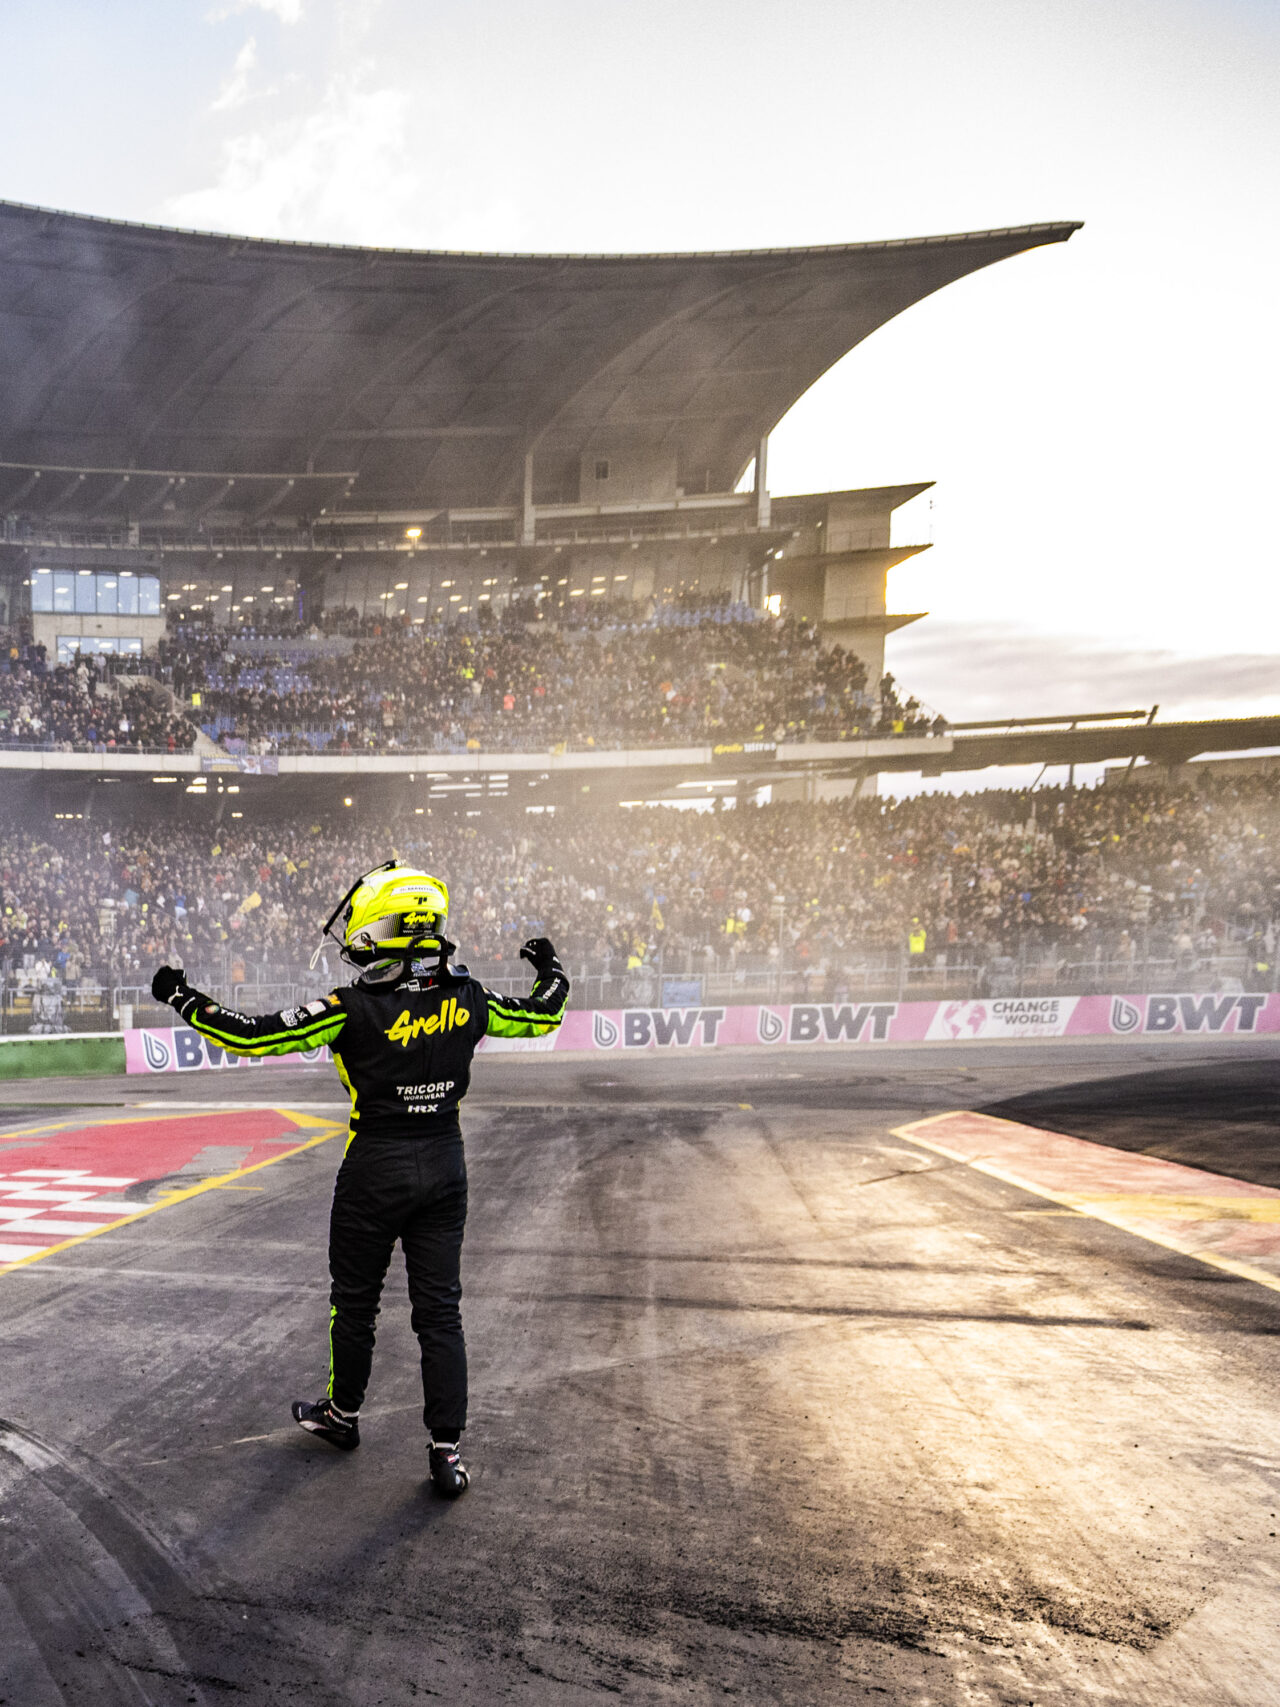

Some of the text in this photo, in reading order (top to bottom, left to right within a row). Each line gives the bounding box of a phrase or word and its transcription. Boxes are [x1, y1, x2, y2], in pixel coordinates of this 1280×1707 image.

[403, 911, 436, 925] Grello
[992, 1000, 1060, 1013] CHANGE
[1005, 1013, 1058, 1025] WORLD
[1145, 996, 1266, 1031] BWT
[384, 997, 470, 1047] Grello
[624, 1009, 724, 1047] BWT
[790, 1006, 896, 1042] BWT
[174, 1029, 262, 1069] BW
[396, 1080, 455, 1095] TRICORP
[403, 1093, 445, 1101] WORKWEAR
